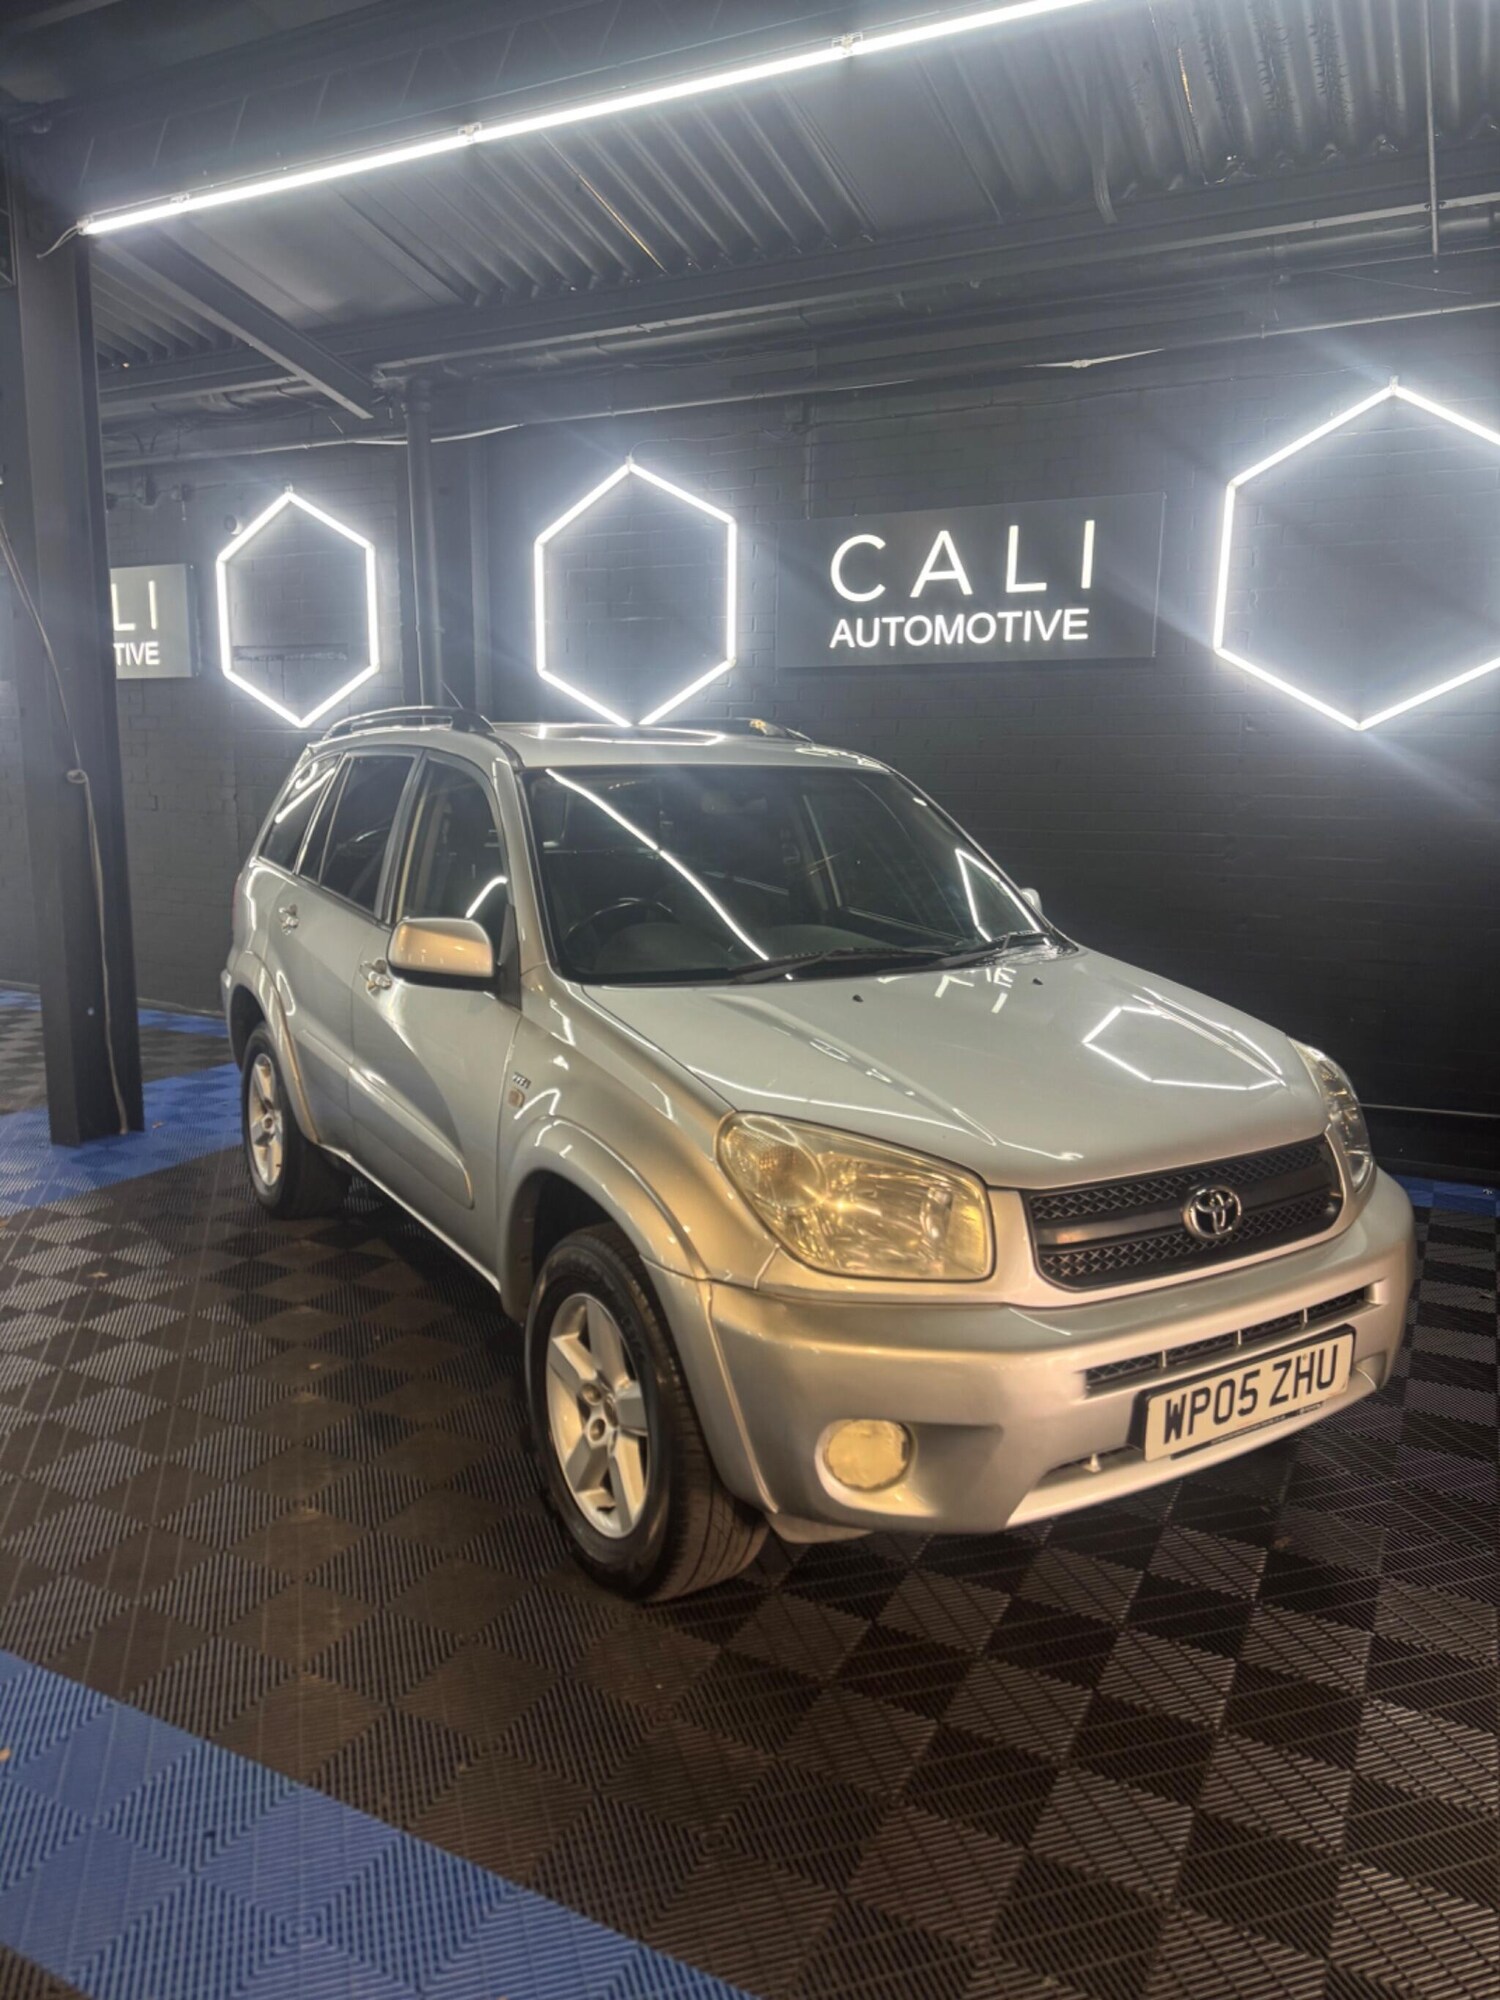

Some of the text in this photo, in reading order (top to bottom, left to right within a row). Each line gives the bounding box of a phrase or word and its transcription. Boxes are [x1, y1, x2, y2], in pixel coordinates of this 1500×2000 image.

[829, 519, 1096, 602] CALI
[829, 607, 1091, 649] AUTOMOTIVE
[1163, 1369, 1262, 1445] WP05
[1268, 1344, 1339, 1407] ZHU
